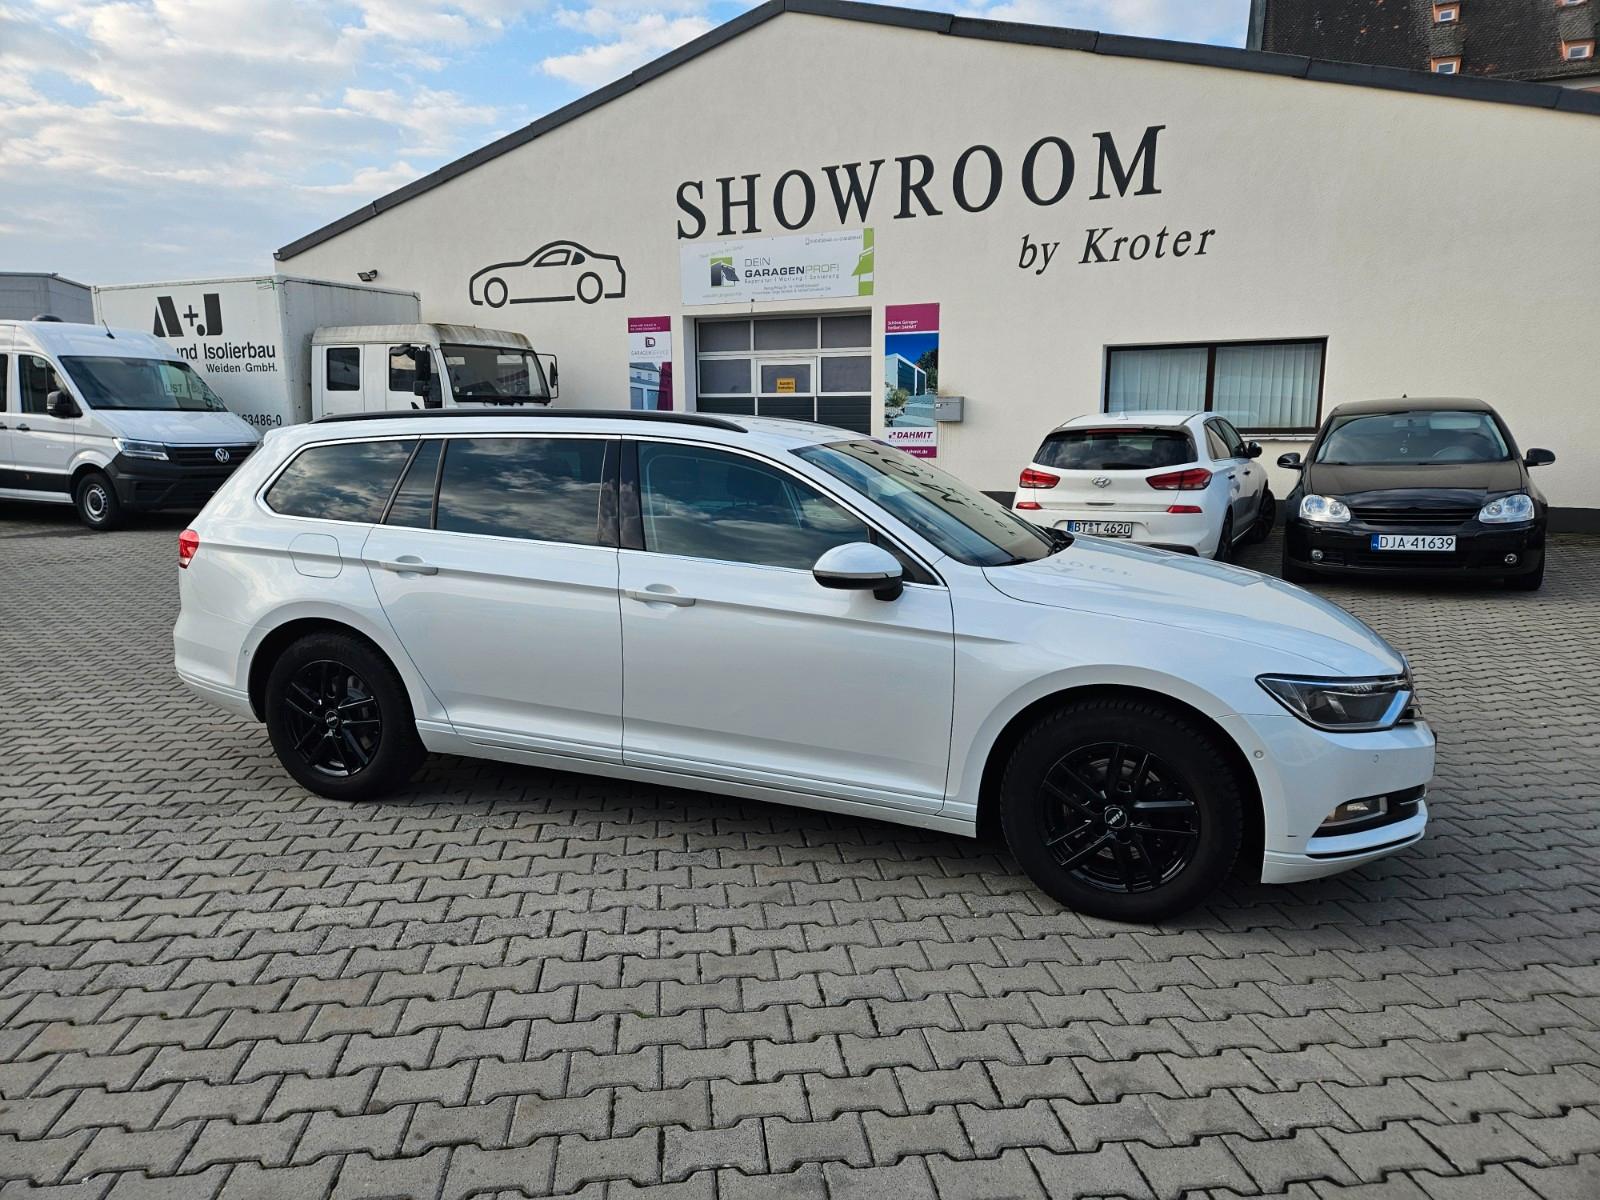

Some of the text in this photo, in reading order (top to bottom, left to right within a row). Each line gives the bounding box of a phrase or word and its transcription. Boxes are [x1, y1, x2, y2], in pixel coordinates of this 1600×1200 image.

[676, 124, 1166, 240] SHOWROOM
[1018, 225, 1215, 276] by Kroter
[744, 256, 771, 267] DEIN
[204, 342, 276, 360] Isolierbau
[206, 362, 279, 373] Weiden GmbH.
[896, 431, 934, 439] DAHMIT
[1074, 522, 1131, 534] BT T 4620
[1379, 536, 1454, 550] DJA 41639
